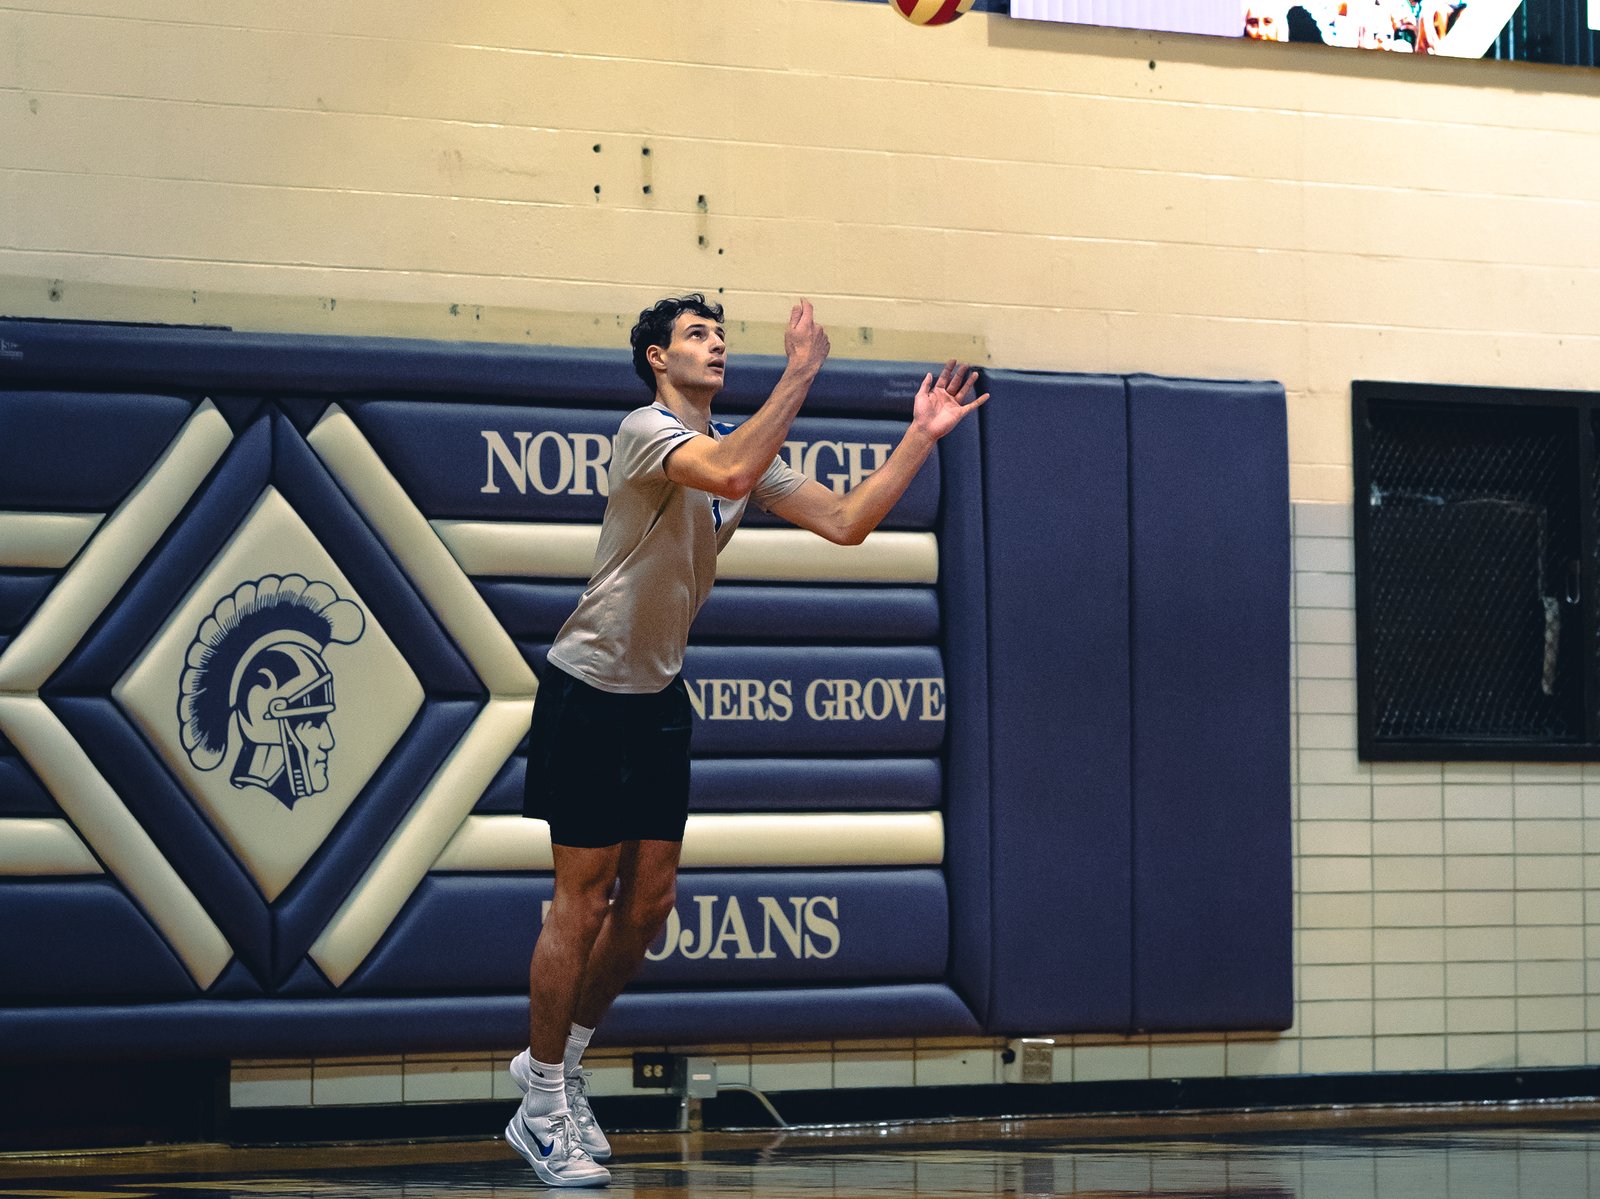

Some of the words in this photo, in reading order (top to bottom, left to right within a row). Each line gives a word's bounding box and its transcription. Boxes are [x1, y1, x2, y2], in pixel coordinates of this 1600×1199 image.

[480, 430, 618, 497] NOR
[783, 440, 892, 496] IGH
[683, 678, 794, 722] NERS
[805, 677, 946, 721] GROVE
